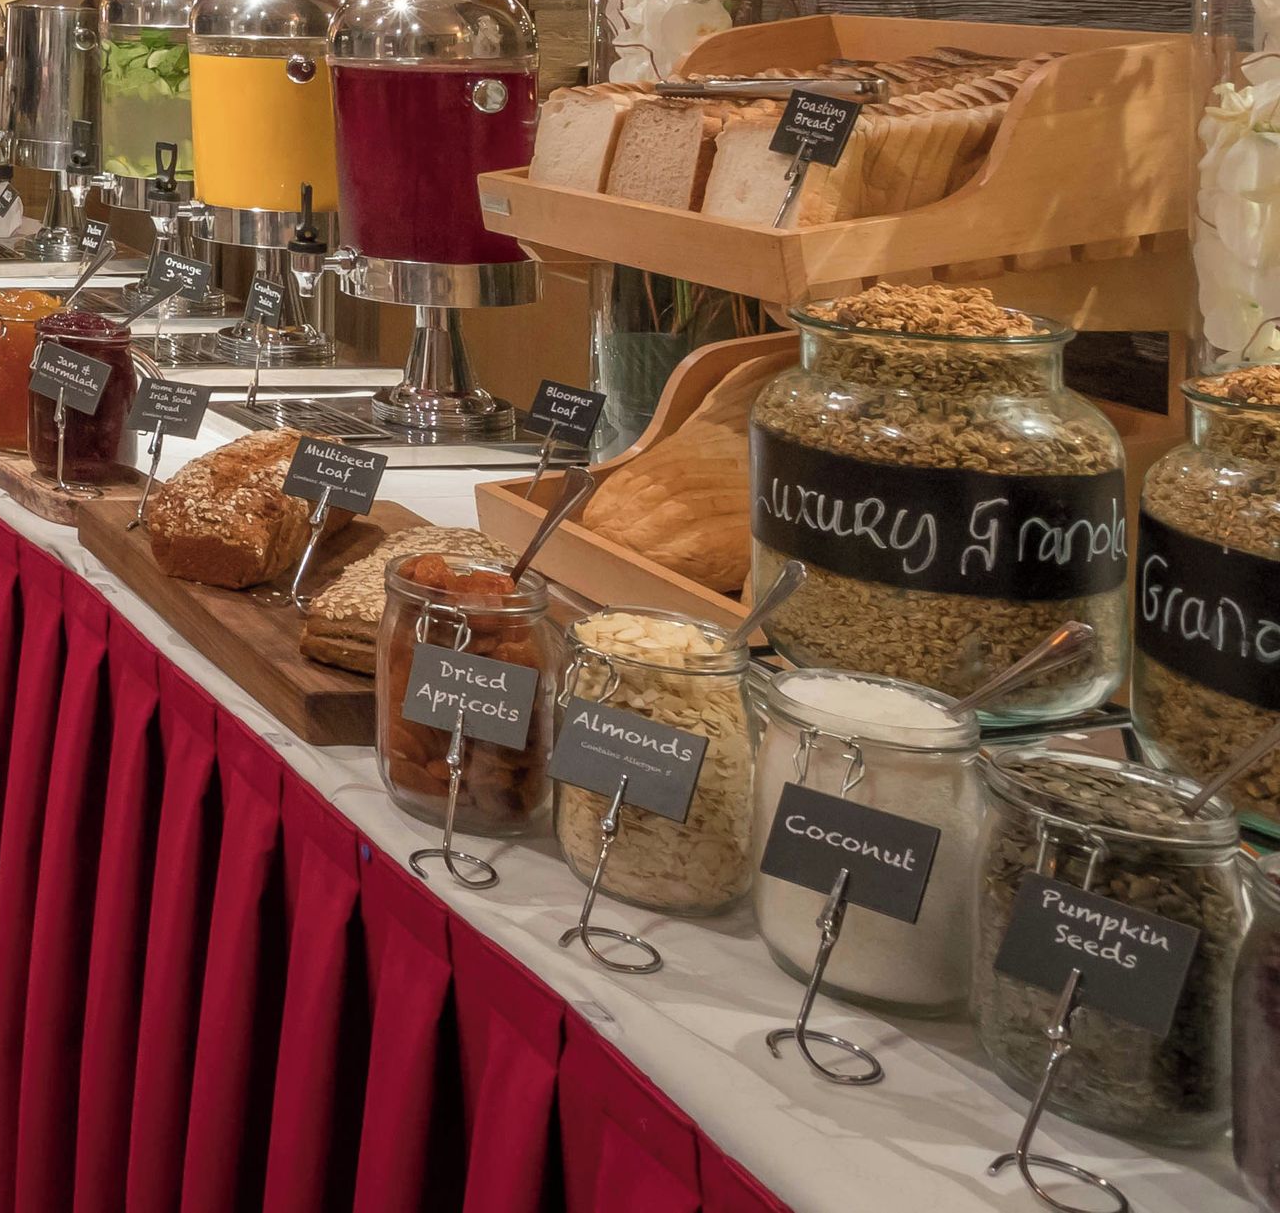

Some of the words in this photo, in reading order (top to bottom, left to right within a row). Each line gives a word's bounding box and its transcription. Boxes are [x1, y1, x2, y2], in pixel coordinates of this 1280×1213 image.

[797, 97, 846, 123] Toasting
[794, 112, 835, 132] Breads
[165, 257, 202, 276] Orange
[166, 269, 193, 285] Jce
[254, 282, 281, 304] Cranberry
[258, 295, 273, 308] Juice
[41, 361, 99, 392] Marmalade
[56, 355, 78, 371] Jam
[81, 364, 91, 376] &
[148, 392, 169, 401] Irish
[172, 395, 192, 405] Soda
[150, 382, 173, 393] Home
[175, 386, 197, 397] Made
[545, 386, 593, 407] Bloomer
[154, 402, 180, 413] Bread
[550, 401, 579, 420] Loaf
[304, 443, 375, 470] Multiseed
[317, 461, 354, 483] Loaf
[440, 660, 508, 692] Dried
[416, 682, 520, 722] Apricots
[573, 711, 693, 762] Almonds
[580, 741, 621, 760] Contains
[623, 754, 662, 773] Allergen
[785, 815, 916, 872] Coconut
[1042, 889, 1170, 951] Pumpkin
[1055, 924, 1137, 968] Seeds
